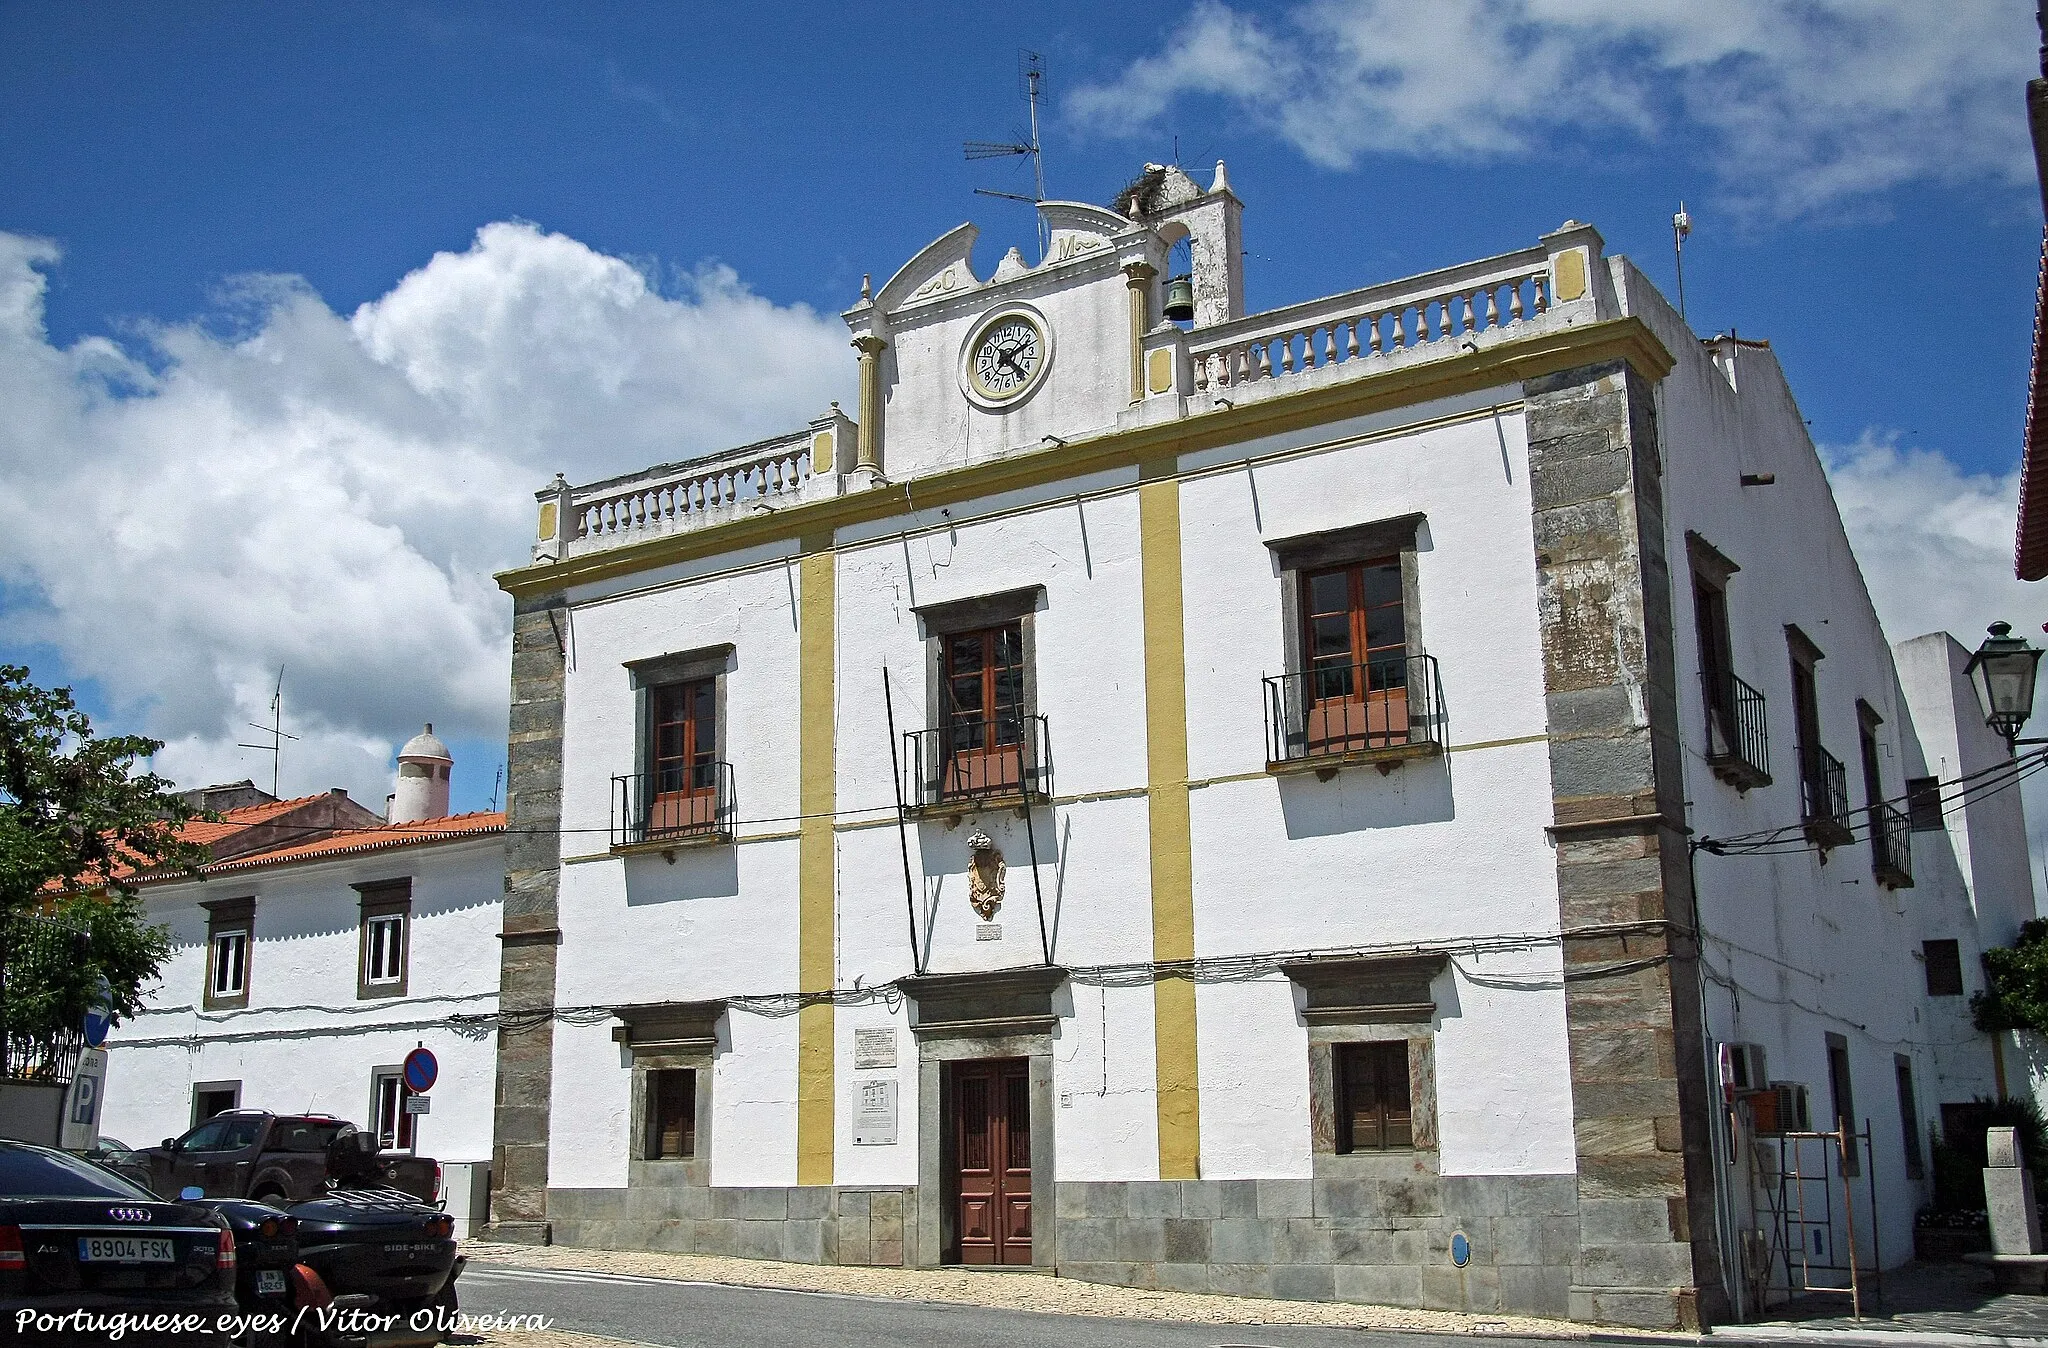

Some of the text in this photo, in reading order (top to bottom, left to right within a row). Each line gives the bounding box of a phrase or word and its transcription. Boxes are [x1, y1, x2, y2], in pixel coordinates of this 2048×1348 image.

[1003, 327, 1012, 337] 12
[994, 334, 1000, 343] 11
[1025, 333, 1031, 344] 2
[984, 346, 992, 355] 10
[1028, 347, 1034, 356] 3
[981, 359, 987, 368] 9
[1025, 361, 1030, 370] 4
[984, 372, 990, 380] 8
[994, 378, 1000, 389] 7
[1004, 378, 1011, 388] 6
[75, 1077, 94, 1121] P
[91, 1240, 171, 1259] 8904 FSK
